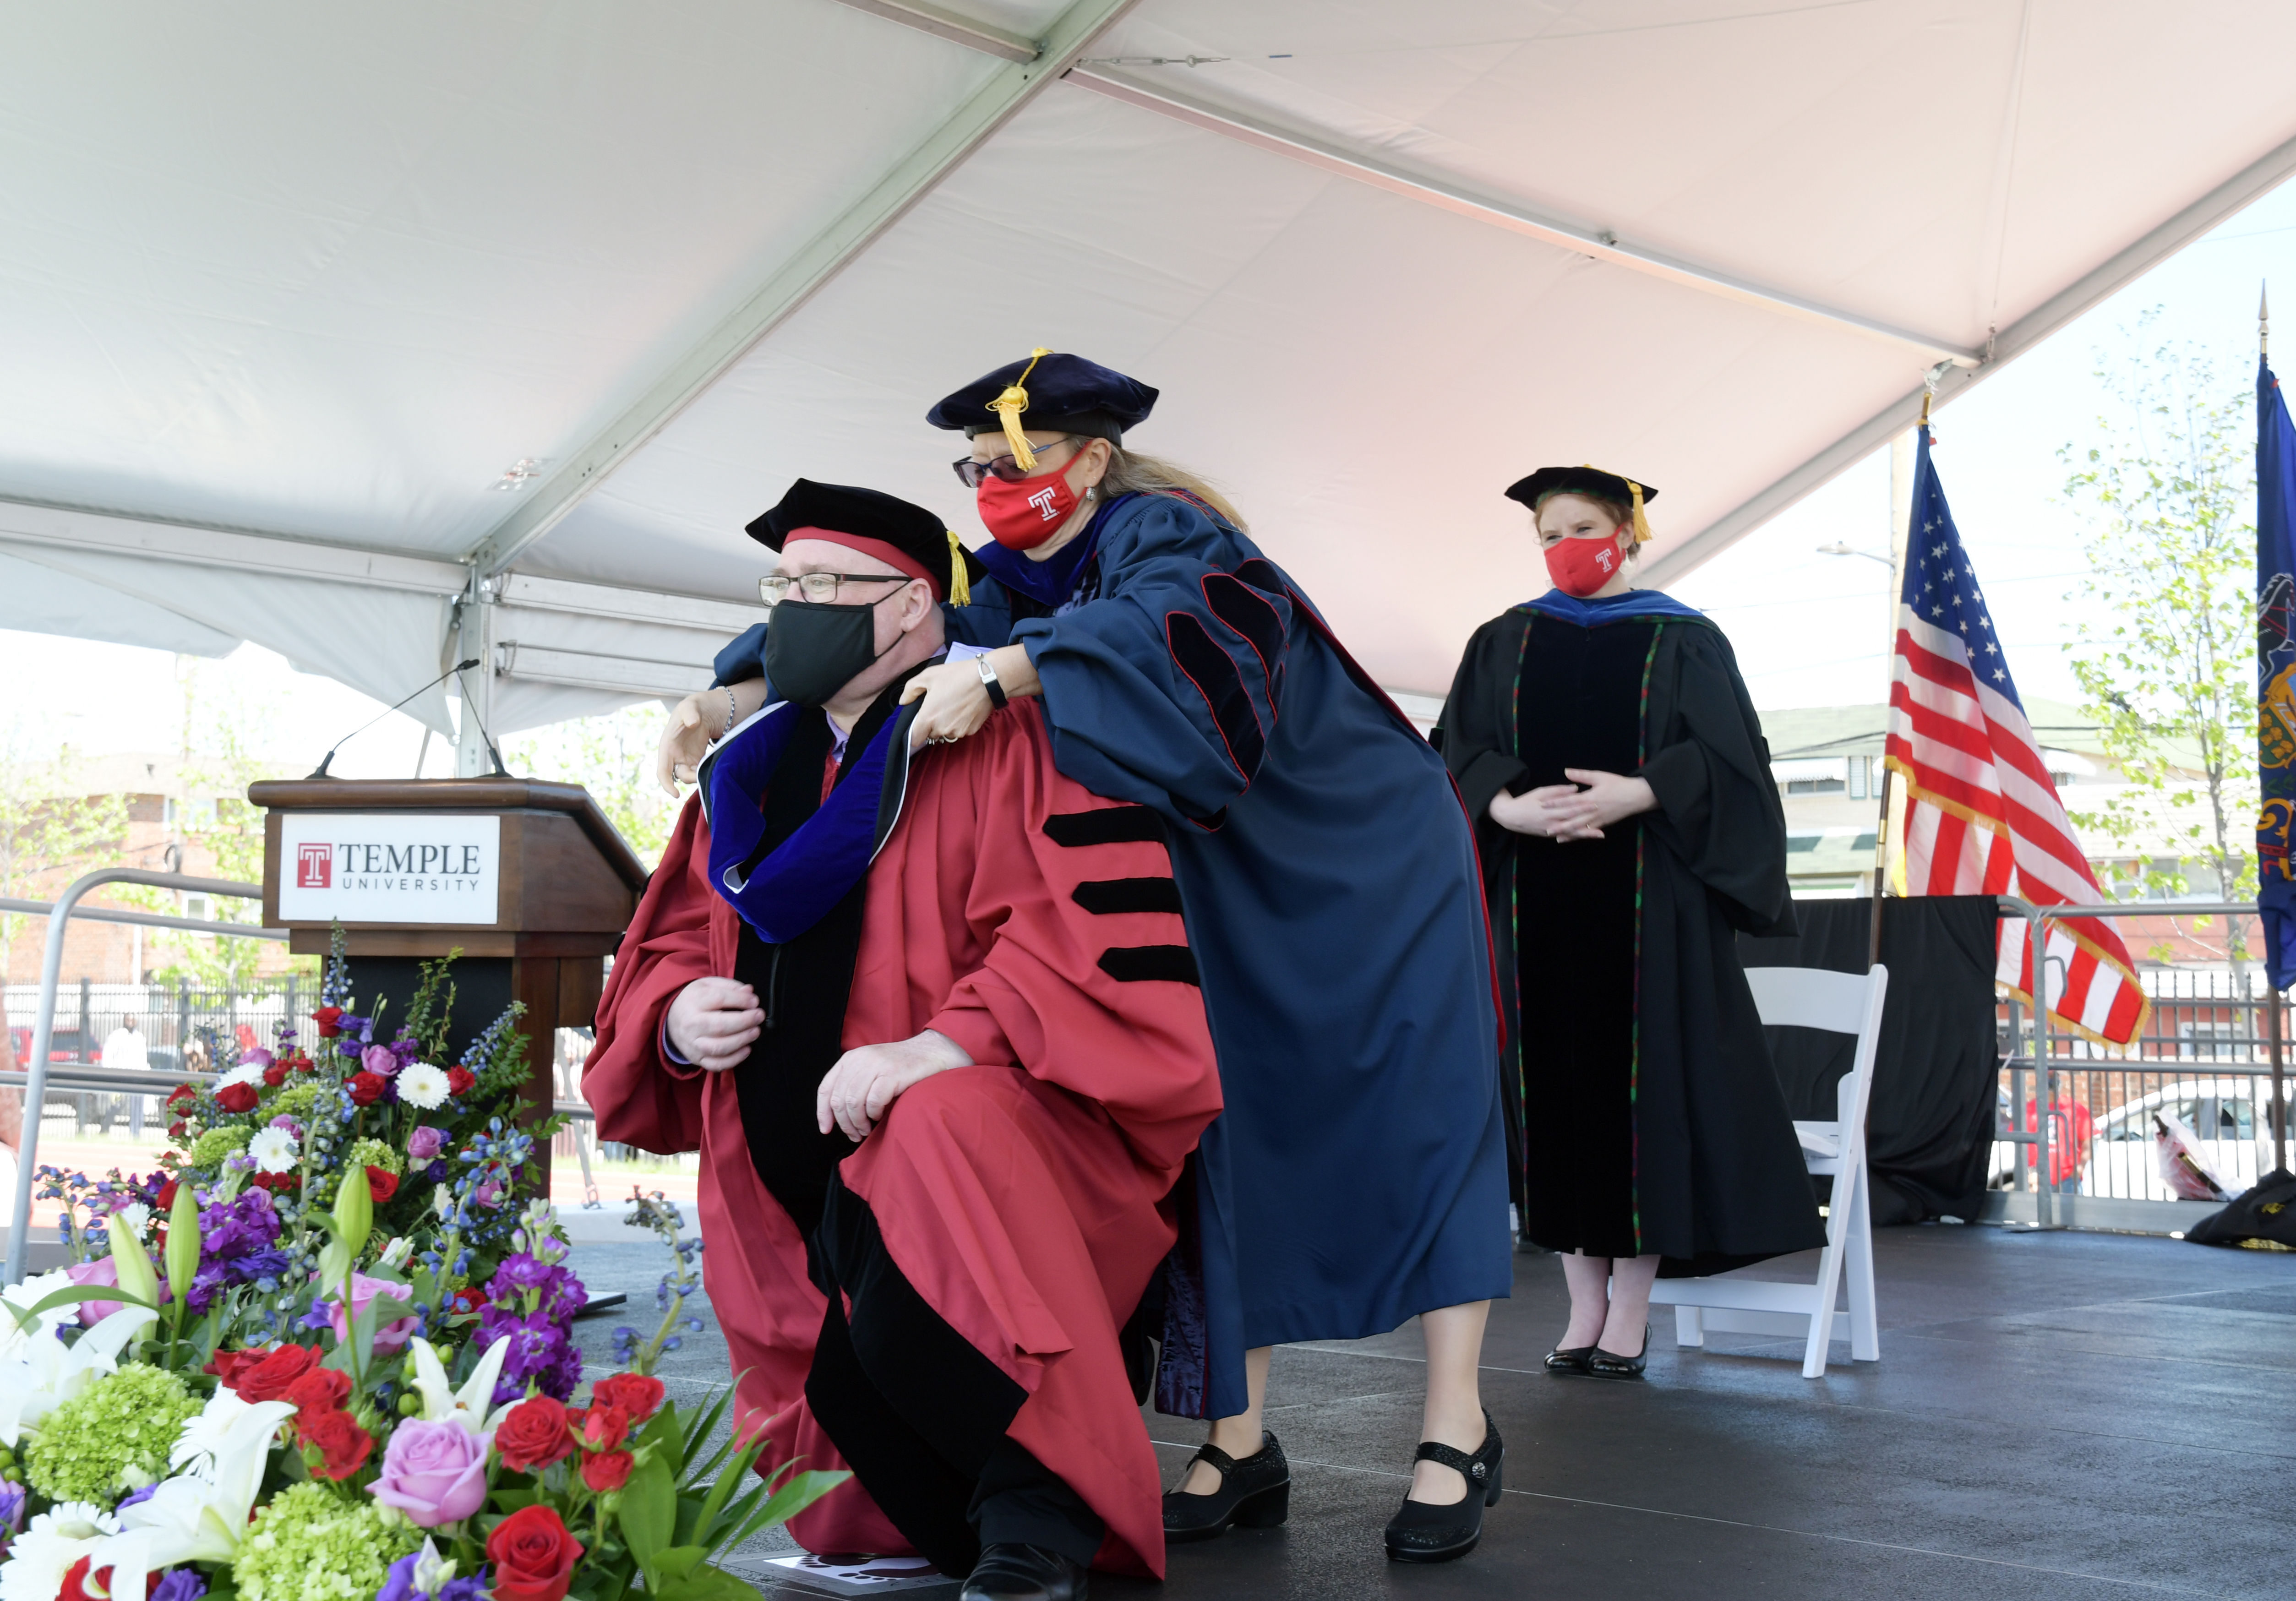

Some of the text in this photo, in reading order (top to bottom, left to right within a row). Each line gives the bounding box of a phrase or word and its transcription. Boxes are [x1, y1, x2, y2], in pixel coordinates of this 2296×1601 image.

[1027, 486, 1059, 521] T
[1595, 548, 1612, 572] T
[299, 844, 331, 887] T
[339, 844, 480, 874] TEMPLE
[343, 878, 478, 891] UNIVERSITY
